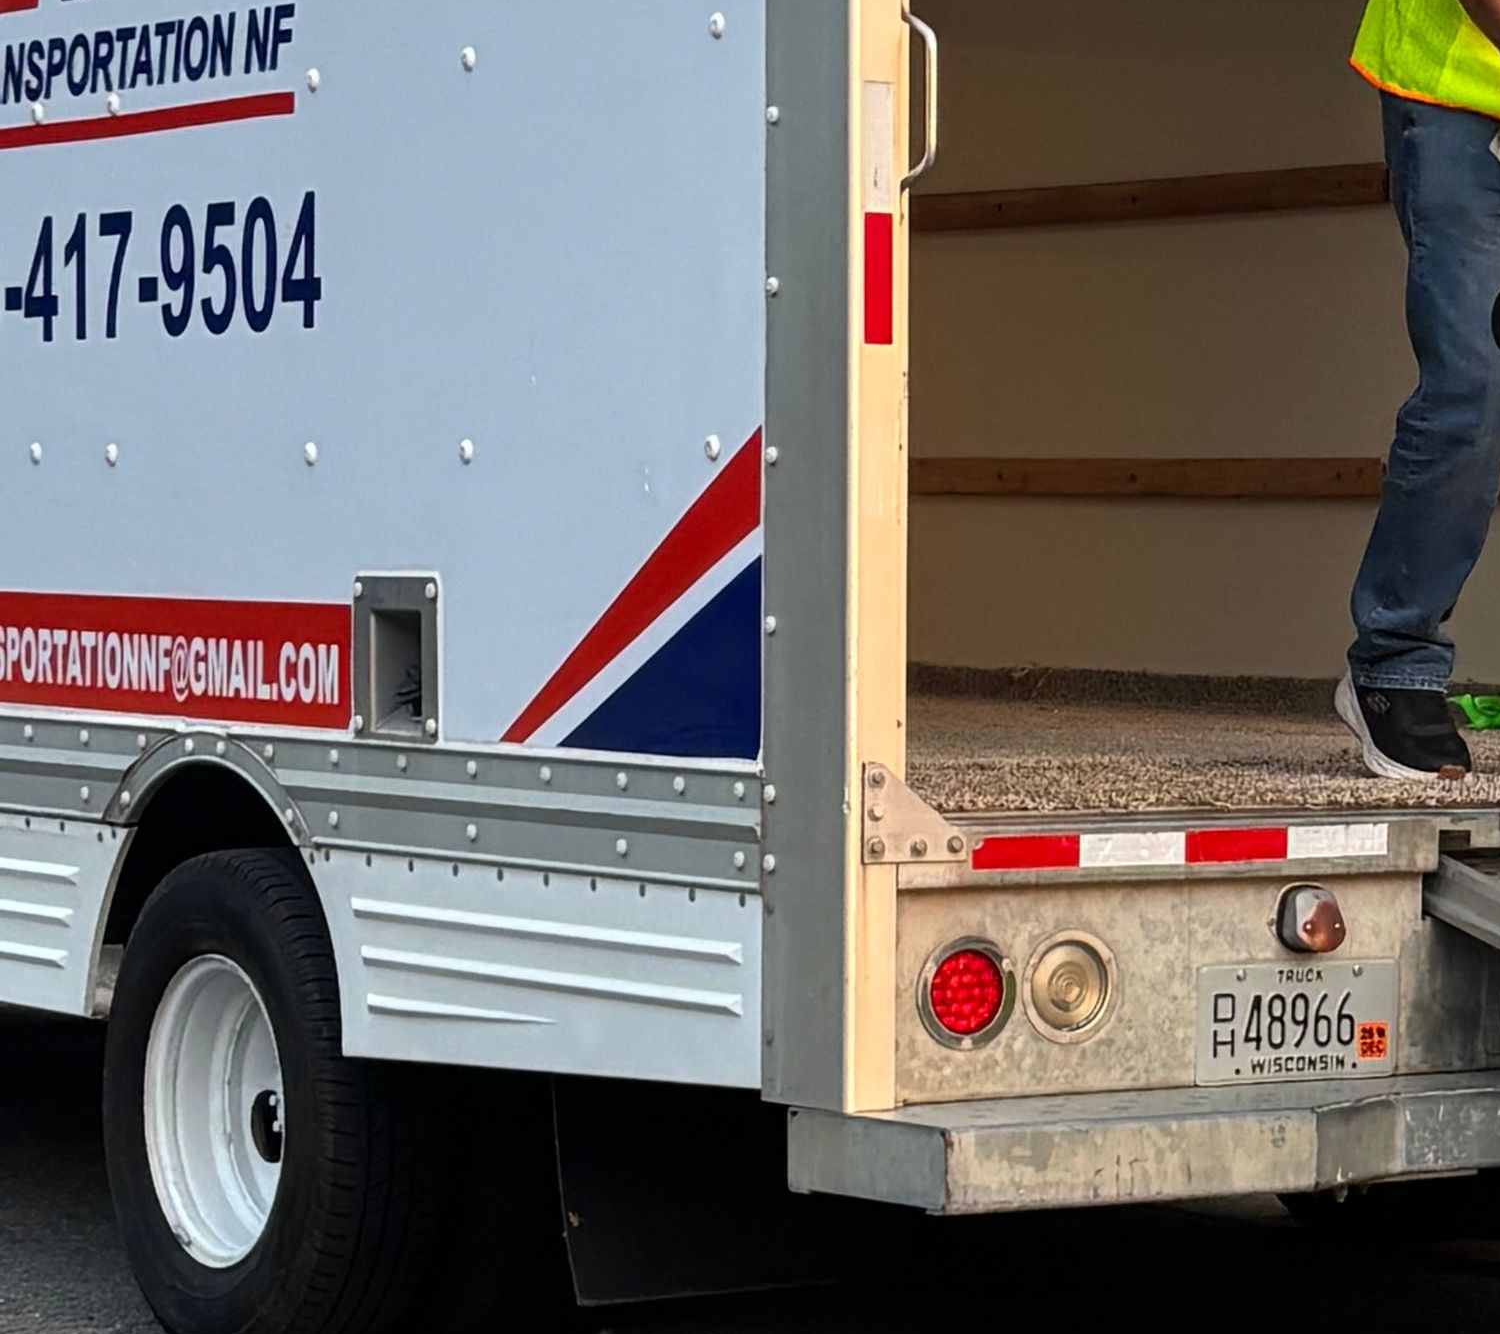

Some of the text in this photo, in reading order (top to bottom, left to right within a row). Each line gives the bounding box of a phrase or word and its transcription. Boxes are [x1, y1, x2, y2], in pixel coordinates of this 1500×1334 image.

[244, 3, 295, 74] NF
[5, 191, 321, 342] -417-9504
[1277, 969, 1323, 984] TRUCK
[1243, 991, 1355, 1051] 48966
[1250, 1054, 1345, 1075] WISCONSIN
